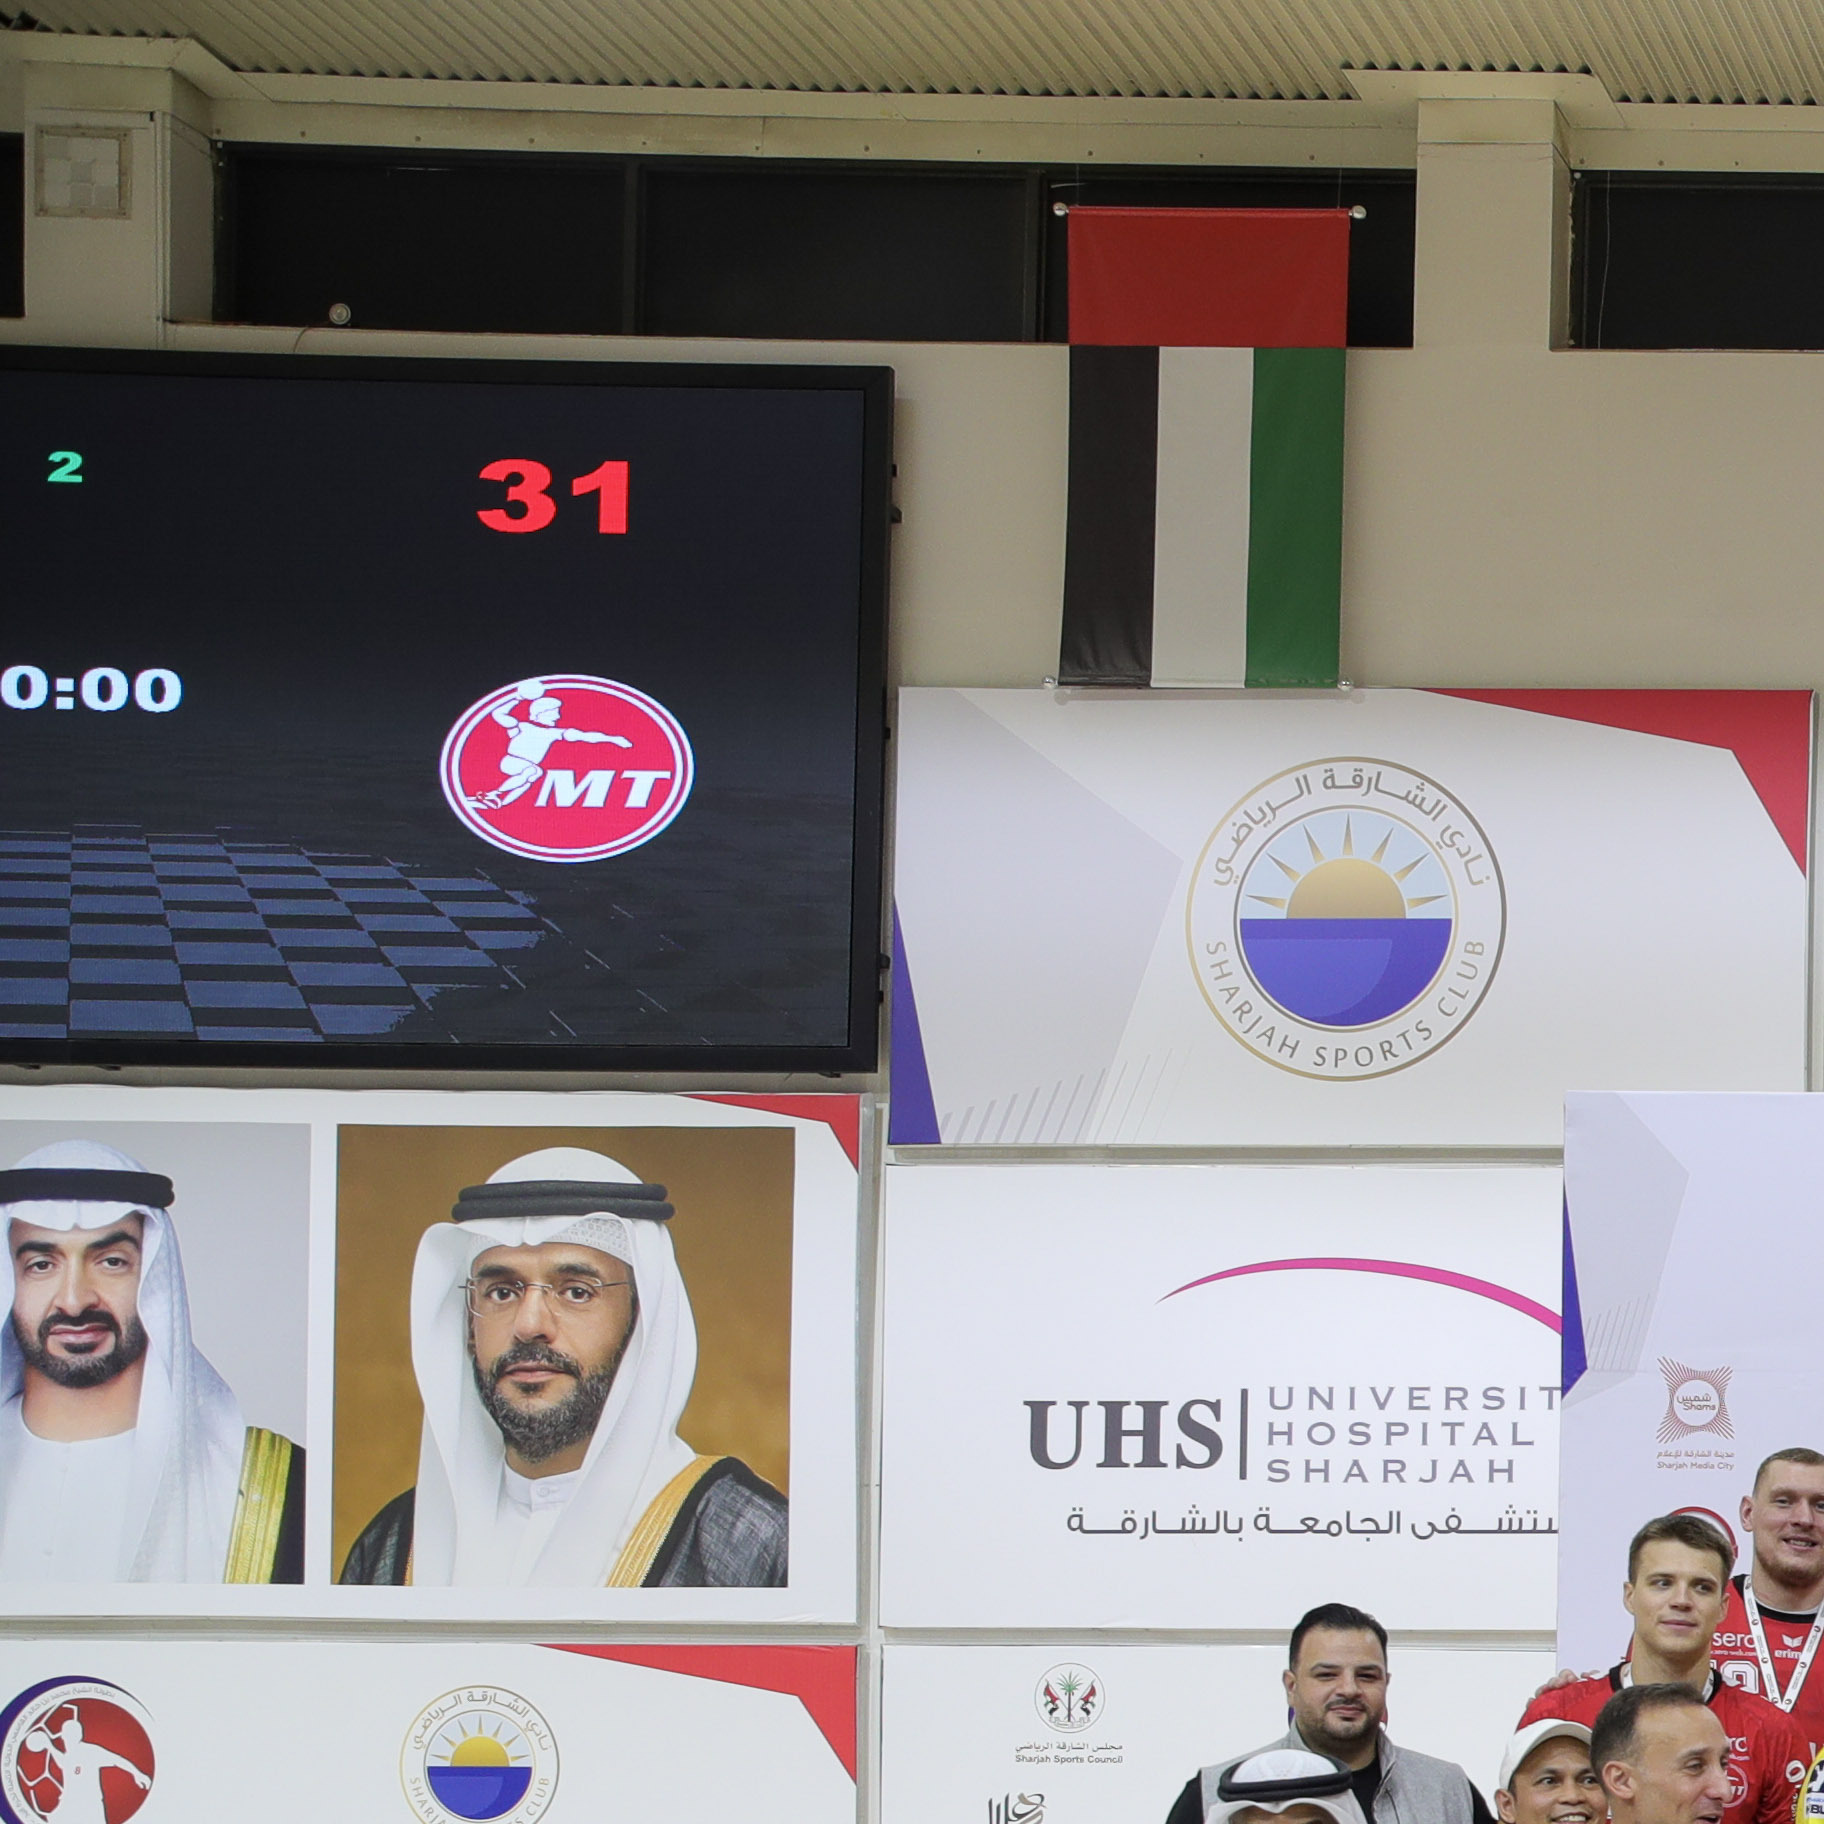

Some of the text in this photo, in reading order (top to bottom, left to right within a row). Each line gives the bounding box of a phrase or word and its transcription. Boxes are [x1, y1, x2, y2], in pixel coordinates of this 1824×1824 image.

[47, 451, 83, 483] 2
[476, 458, 630, 535] 31
[535, 769, 671, 808] MT
[1213, 767, 1491, 886] نادي الشارقة الرياضي
[1206, 940, 1486, 1068] SHARJAH SPORTS CLUB
[1266, 1386, 1562, 1411] UNIVERSIT
[1022, 1397, 1224, 1470] UHS
[1266, 1420, 1535, 1447] HOSPITAL
[1266, 1458, 1516, 1484] SHARJAH
[1067, 1504, 1559, 1541] تشفى الجامعة بالشارقة
[1015, 1754, 1123, 1764] Sharjah Sports Council
[525, 1777, 550, 1816] CLUB
